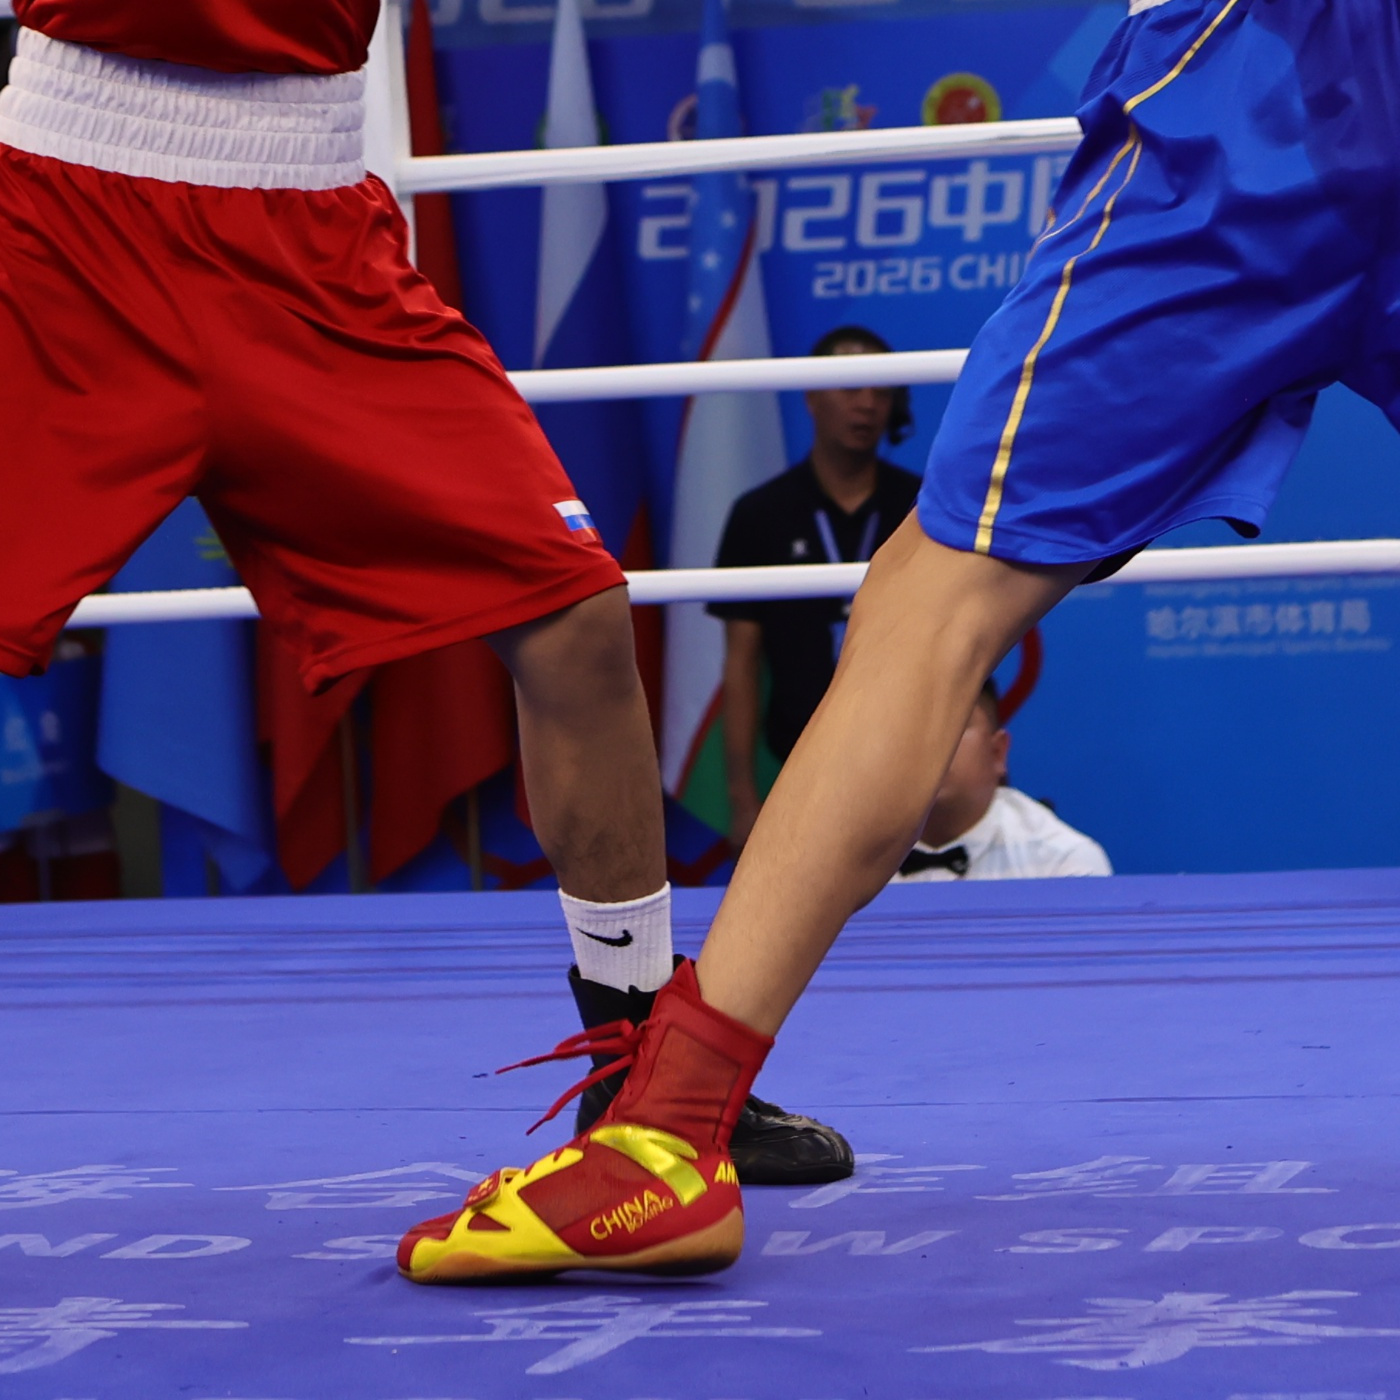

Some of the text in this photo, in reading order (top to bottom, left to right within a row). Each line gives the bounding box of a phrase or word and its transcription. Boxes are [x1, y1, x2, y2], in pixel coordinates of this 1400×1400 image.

[812, 255, 941, 299] 2026
[714, 1160, 740, 1188] AN
[590, 1189, 664, 1240] CHINA
